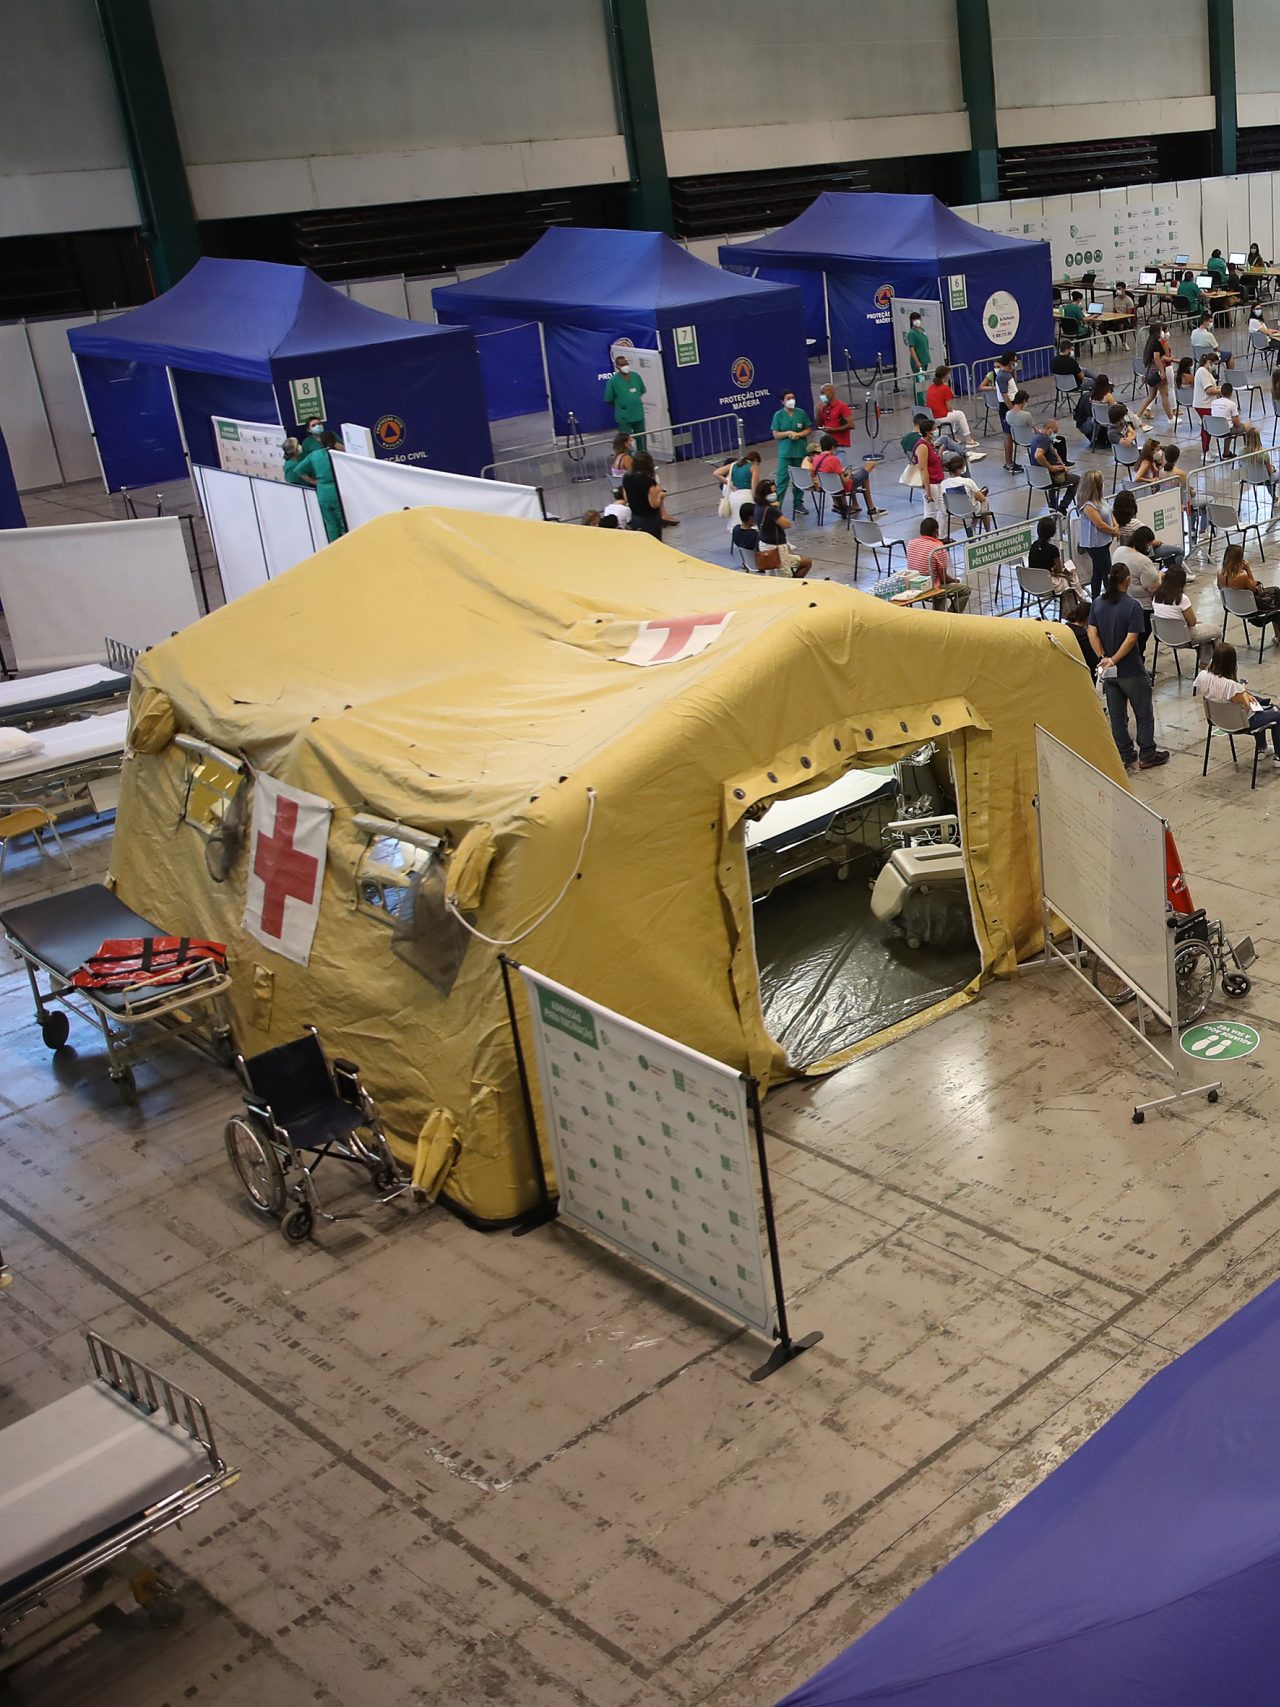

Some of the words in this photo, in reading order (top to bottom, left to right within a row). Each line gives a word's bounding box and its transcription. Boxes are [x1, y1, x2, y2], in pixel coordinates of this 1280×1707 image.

[954, 278, 960, 288] 6
[681, 330, 687, 341] 7
[302, 382, 310, 395] 8
[719, 392, 754, 405] PROTEÇÃO
[754, 389, 771, 398] CIVIL
[732, 399, 761, 410] MADEIRA
[407, 451, 429, 461] CIVIL
[975, 547, 987, 556] SALA
[988, 544, 995, 552] DE
[995, 534, 1024, 549] OBSERVAÇÃO
[972, 556, 982, 567] PÓS
[981, 548, 1008, 565] VACINAÇÃO
[1008, 542, 1029, 555] COVID-19
